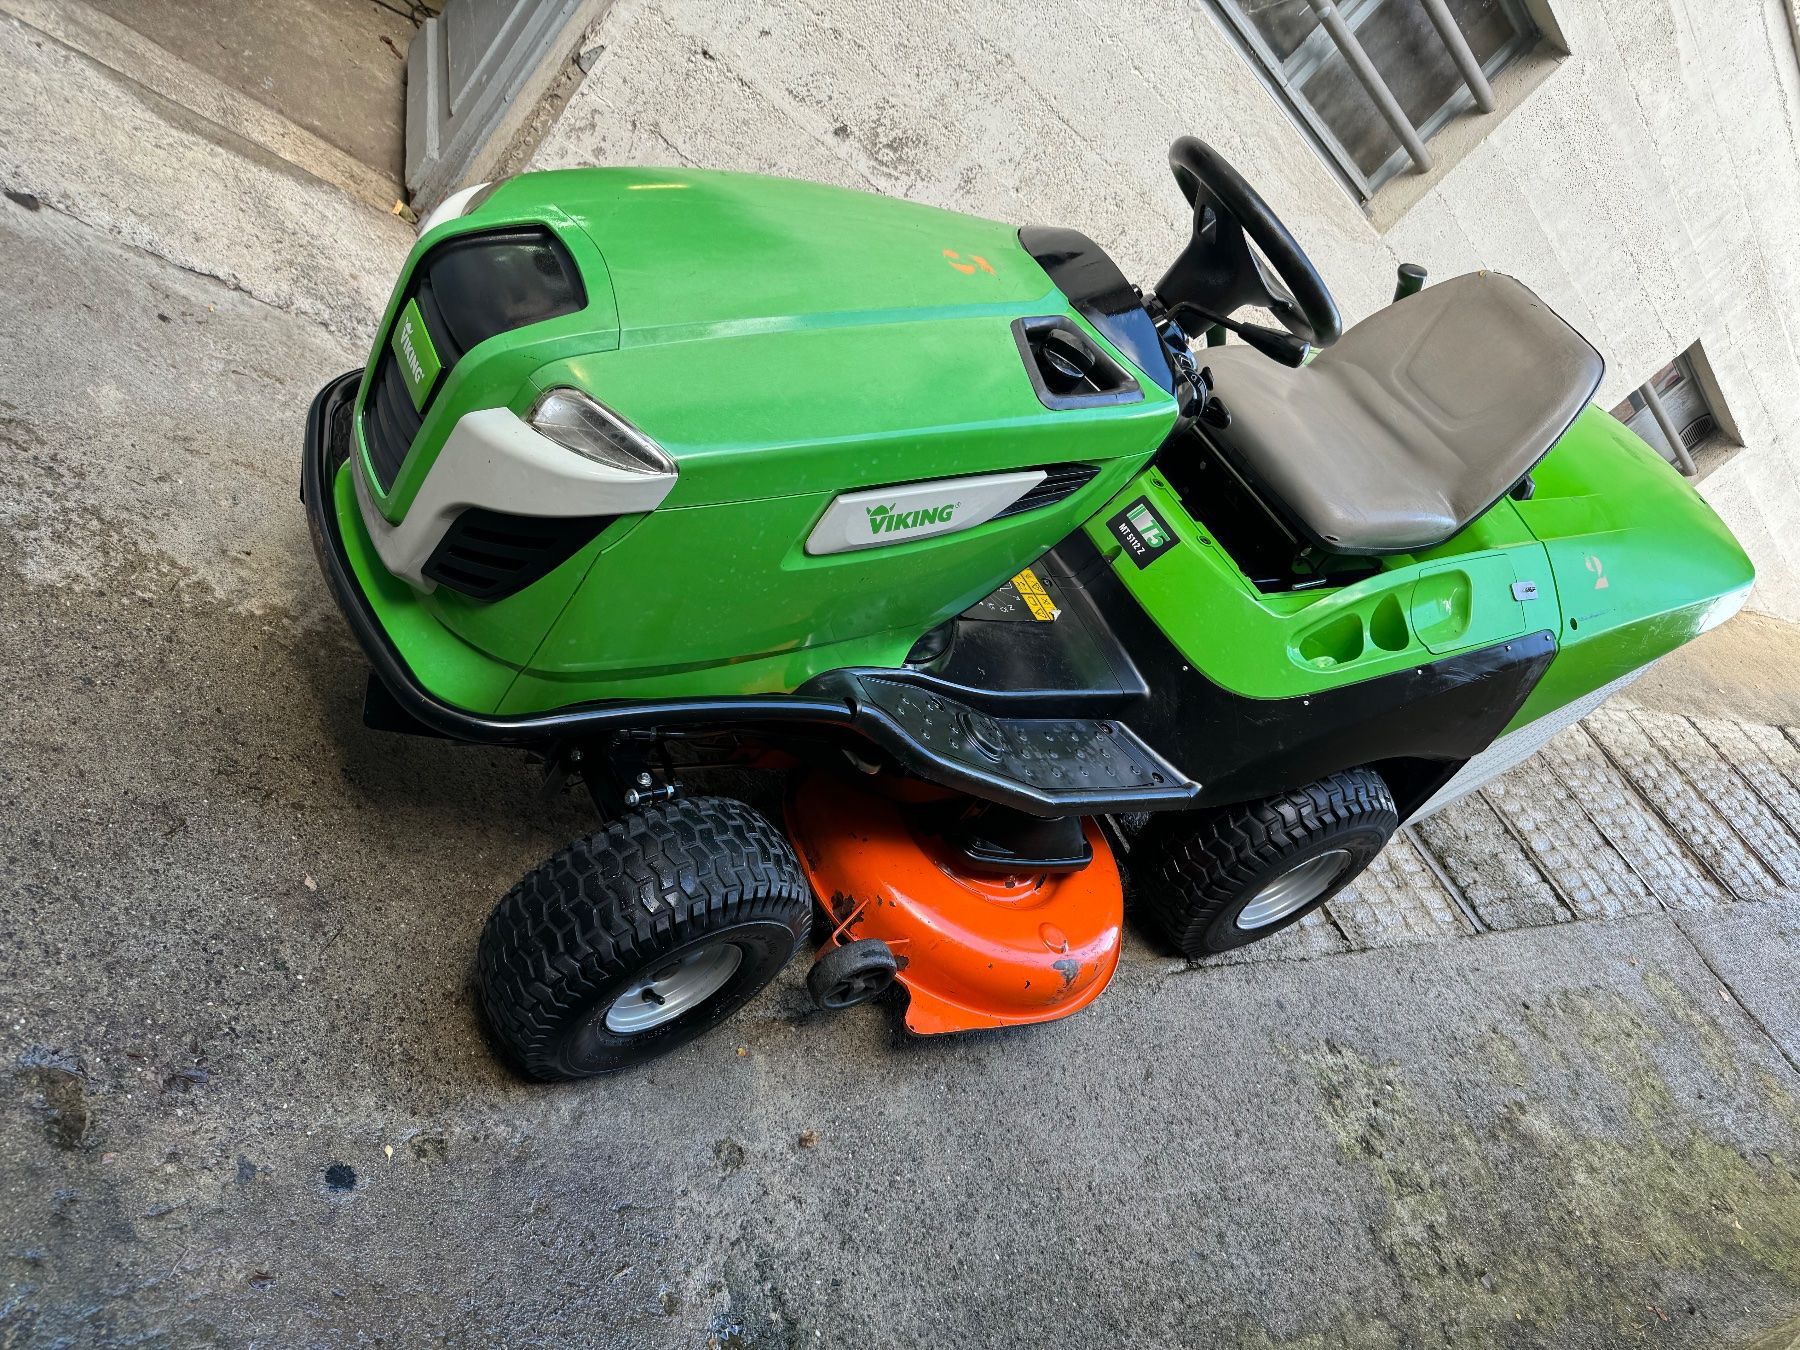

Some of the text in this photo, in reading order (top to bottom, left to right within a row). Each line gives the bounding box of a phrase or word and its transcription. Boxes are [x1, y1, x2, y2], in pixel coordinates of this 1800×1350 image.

[401, 326, 423, 384] VIKING
[869, 503, 954, 534] VIKING
[1118, 523, 1145, 555] MT 5112 Z
